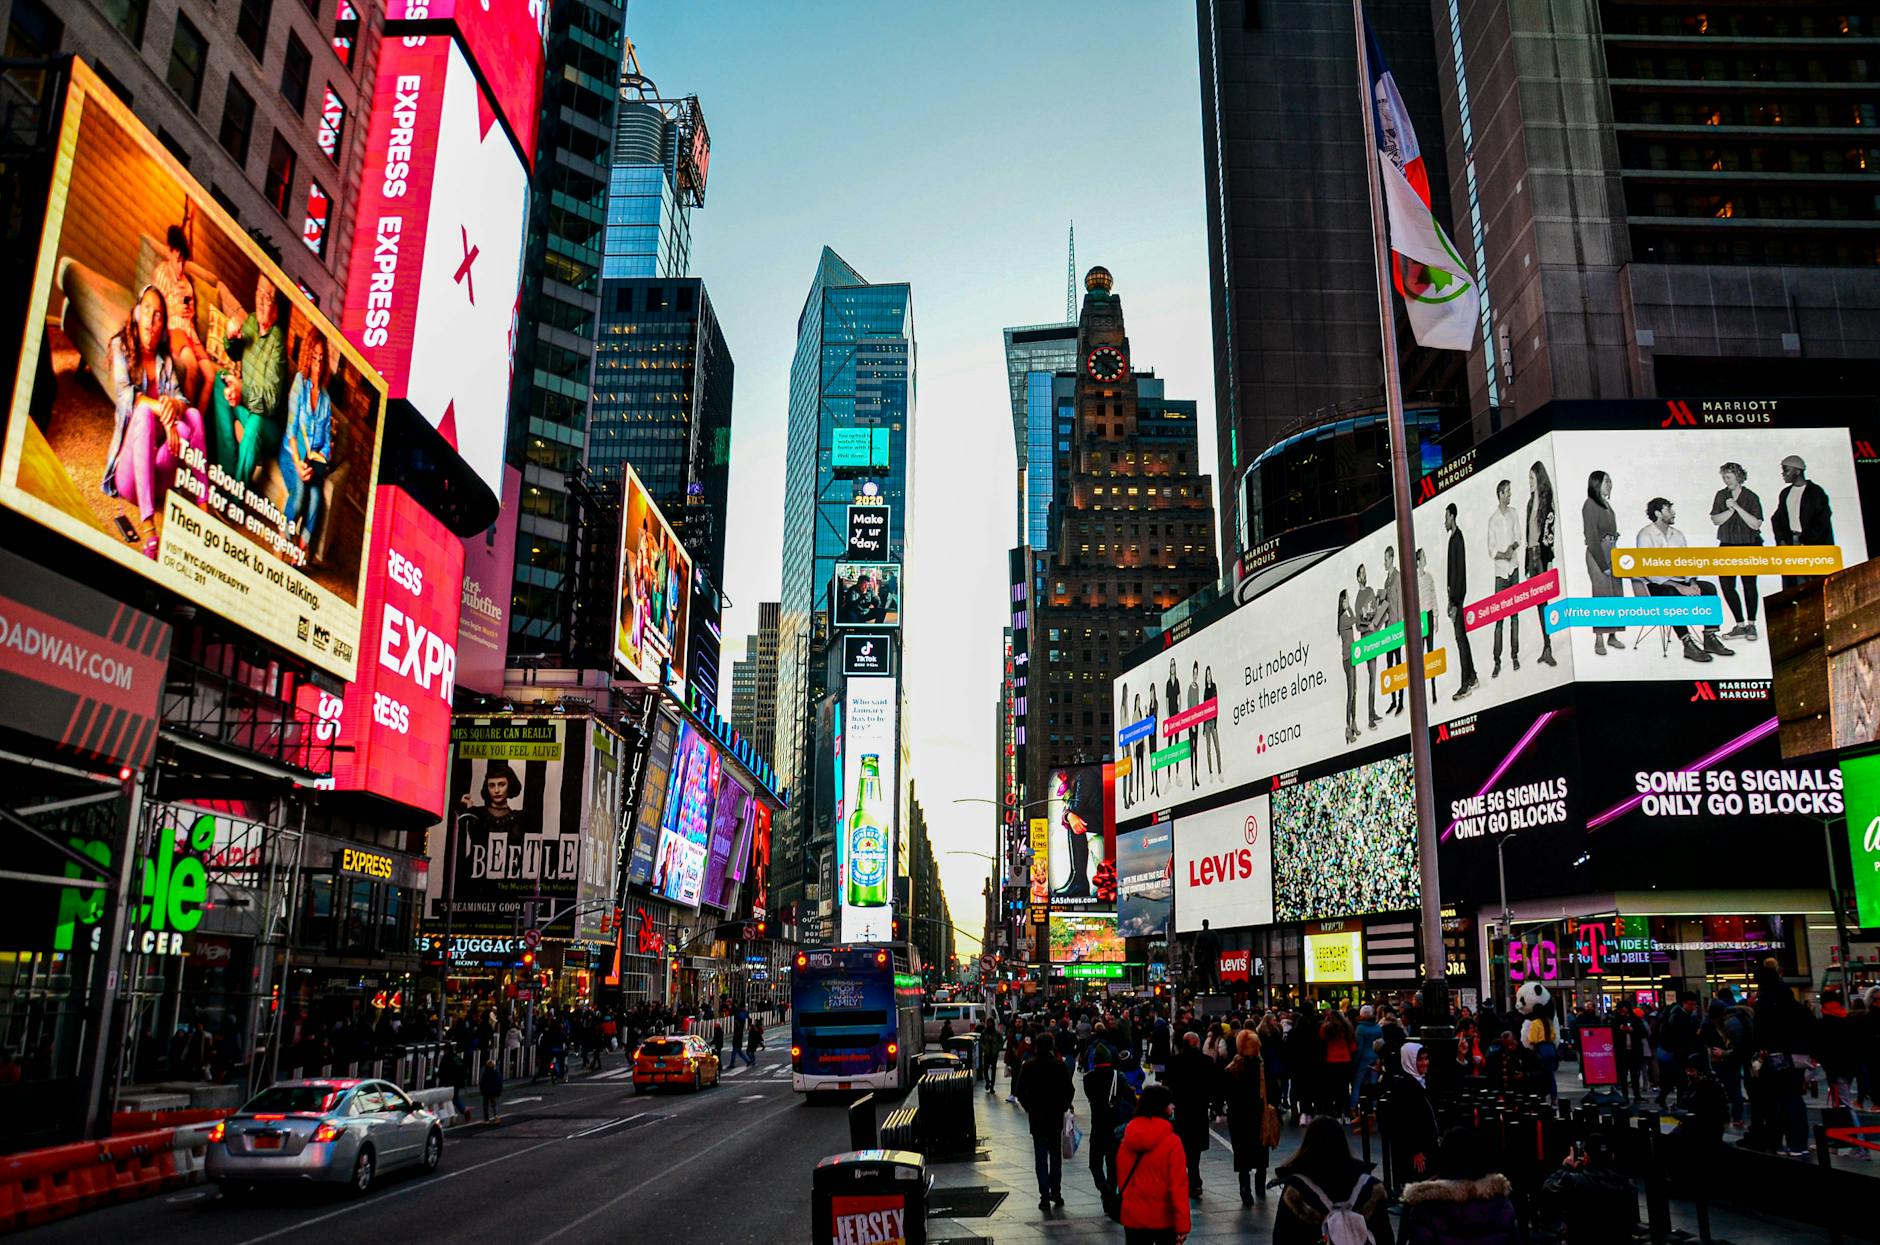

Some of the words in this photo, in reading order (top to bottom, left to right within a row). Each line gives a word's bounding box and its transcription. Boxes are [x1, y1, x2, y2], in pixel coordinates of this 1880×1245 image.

[382, 75, 421, 198] EXPRESS
[363, 216, 402, 347] EXPRESS
[1703, 401, 1778, 411] MARRIOTT
[1704, 414, 1771, 424] MARQUIS
[1437, 449, 1477, 477] MARRIOTT
[179, 438, 206, 474] Talk
[208, 464, 245, 500] about
[245, 489, 288, 533] making
[288, 520, 296, 536] a
[1439, 464, 1473, 490] MARQUIS
[855, 495, 884, 506] 2020
[175, 467, 206, 499] plan
[208, 485, 228, 512] for
[227, 503, 245, 525] an
[245, 514, 307, 566] emergency.
[853, 514, 884, 525] Make
[171, 502, 202, 538] Then
[205, 526, 220, 548] go
[223, 536, 250, 568] back
[253, 556, 264, 575] to
[267, 567, 284, 588] not
[286, 575, 320, 611] talking.
[1244, 538, 1280, 562] MARRIOTT
[163, 554, 177, 568] OR
[176, 560, 193, 580] CALL
[194, 571, 207, 587] 211
[165, 540, 184, 557] VISIT
[183, 547, 250, 596] NYC.GOV/READYNY
[1245, 552, 1276, 573] MARQUIS
[1642, 557, 1671, 568] Make
[1673, 556, 1710, 570] design
[1712, 555, 1768, 567] accessible
[1771, 555, 1783, 566] to
[1784, 555, 1835, 569] everyone
[1478, 607, 1490, 618] Sell
[1501, 597, 1513, 609] that
[1513, 591, 1529, 604] lasts
[1530, 581, 1554, 597] forever
[1564, 607, 1590, 617] Write
[1593, 608, 1615, 617] new
[1618, 605, 1661, 620] product
[1663, 607, 1689, 620] spec
[1691, 605, 1712, 616] doc
[314, 622, 331, 642] NYC
[1245, 663, 1263, 686] But
[1266, 640, 1310, 677] nobody
[1233, 698, 1256, 725] gets
[1259, 688, 1287, 709] there
[1290, 670, 1327, 697] alone.
[1719, 682, 1772, 690] MARRIOTT
[1720, 691, 1768, 699] MARQUIS
[470, 728, 501, 740] SQUARE
[503, 727, 519, 738] CAN
[522, 727, 553, 739] REALLY
[1450, 715, 1478, 730] MARRIOTT
[1450, 724, 1476, 738] MARQUIS
[1267, 723, 1301, 747] asana
[462, 745, 487, 757] MAKE
[490, 744, 506, 757] YOU
[508, 744, 530, 757] FEEL
[532, 744, 559, 757] ALIVE!
[1635, 771, 1701, 793] SOME
[1705, 770, 1737, 792] 5G
[1741, 769, 1844, 792] SIGNALS
[1451, 794, 1486, 820] SOME
[1487, 791, 1505, 813] 5G
[1506, 776, 1568, 809] SIGNALS
[1641, 794, 1702, 816] ONLY
[1707, 793, 1743, 816] GO
[1748, 792, 1844, 815] BLOCKS
[1454, 816, 1487, 840] ONLY
[1488, 812, 1508, 834] GO
[1510, 800, 1567, 830] BLOCKS
[343, 848, 392, 879] EXPRESS
[471, 838, 577, 880] BEETLE
[440, 902, 496, 914] "SREAMINGLY
[1051, 897, 1098, 905] SASshoes.com
[1580, 923, 1606, 973] T
[1509, 940, 1558, 981] 5G
[828, 999, 859, 1007] FAMILY
[832, 1208, 904, 1245] JERSEY
